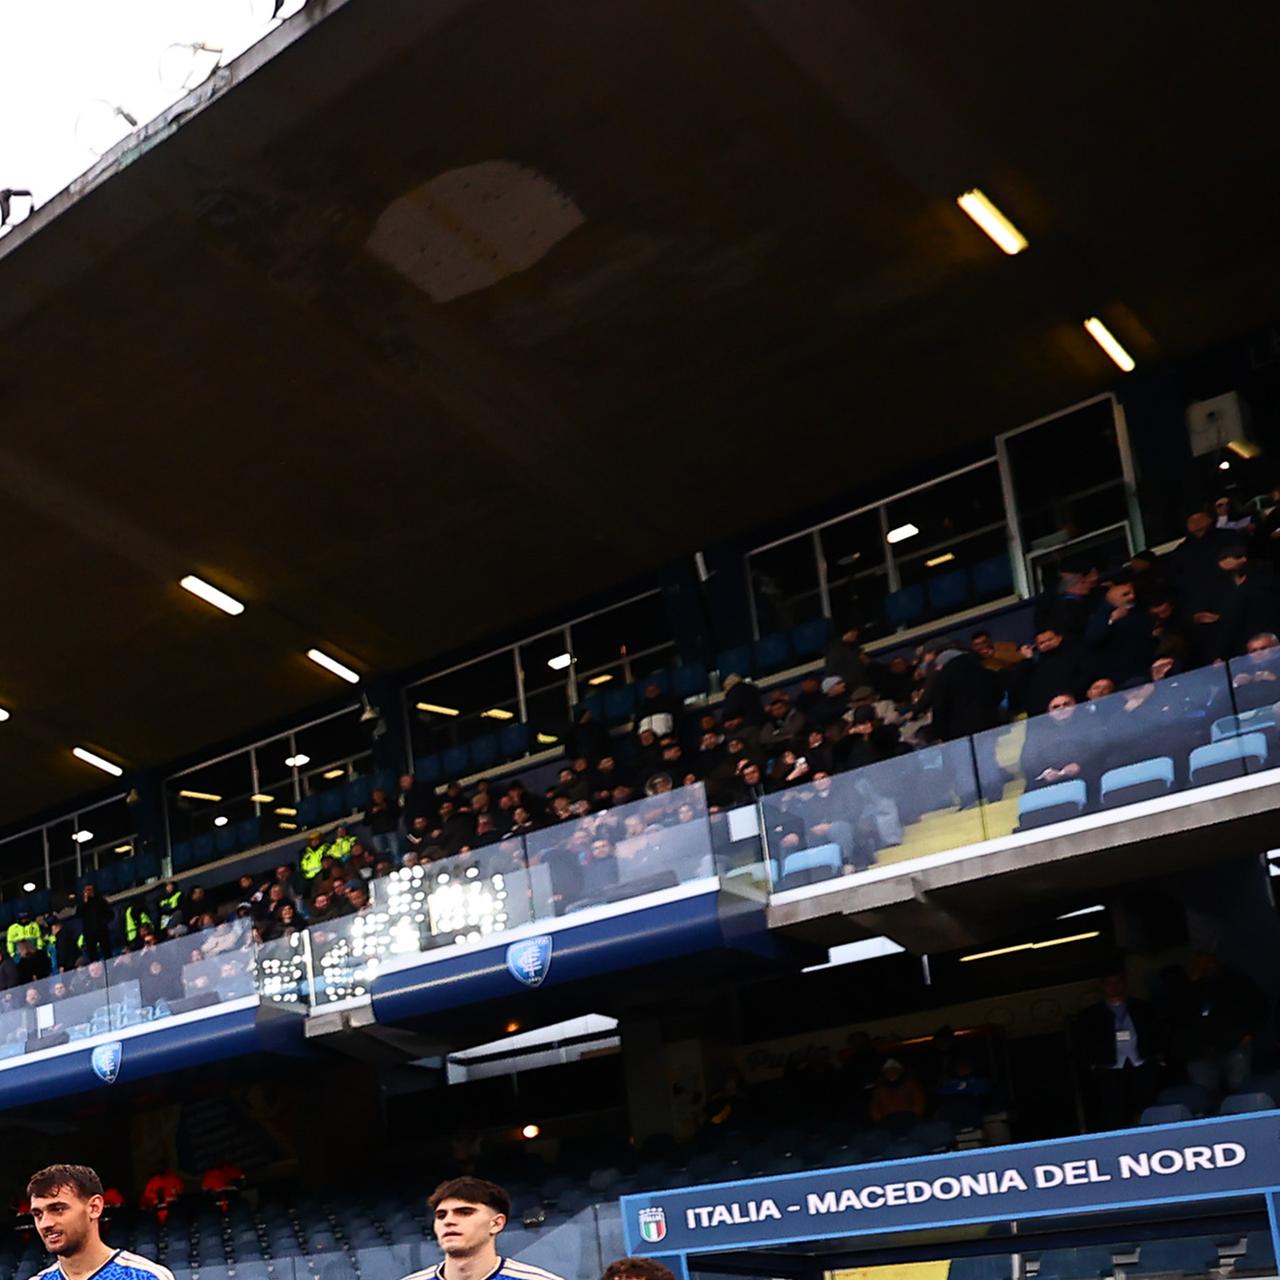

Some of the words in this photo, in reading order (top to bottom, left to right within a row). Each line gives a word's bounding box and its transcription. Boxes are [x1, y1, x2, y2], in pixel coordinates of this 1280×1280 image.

[686, 1199, 782, 1229] ITALIA
[807, 1169, 1028, 1215] MACEDONIA
[1033, 1159, 1111, 1189] DEL
[1118, 1142, 1247, 1179] NORD
